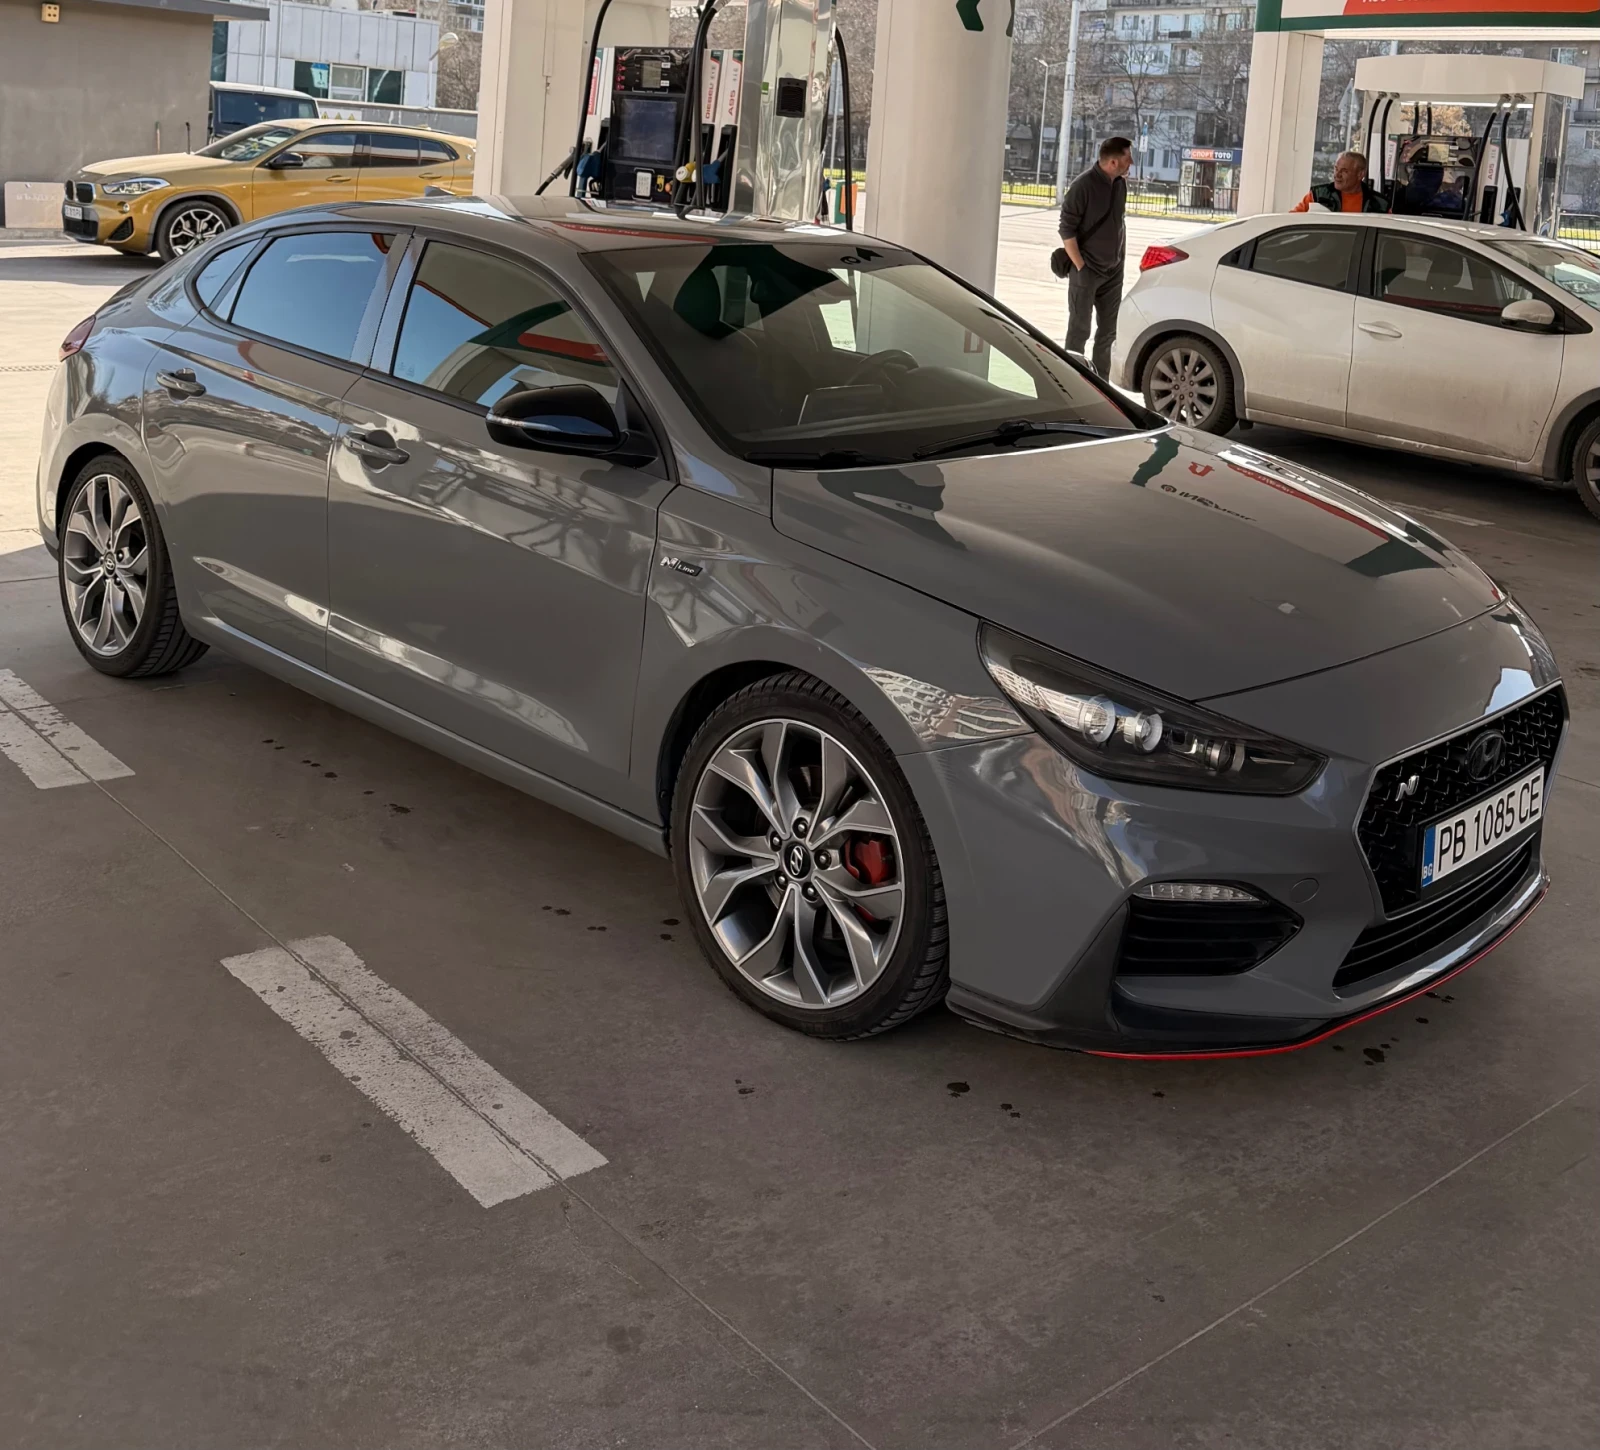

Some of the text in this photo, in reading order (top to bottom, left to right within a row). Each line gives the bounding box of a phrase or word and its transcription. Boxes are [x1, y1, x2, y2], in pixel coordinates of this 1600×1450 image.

[728, 90, 736, 116] A95
[1192, 150, 1231, 159] СПОРТ ТОТО
[660, 556, 695, 574] N Line
[1395, 774, 1419, 802] N
[1437, 775, 1541, 872] PB 1085 CE
[1422, 865, 1433, 880] BG
